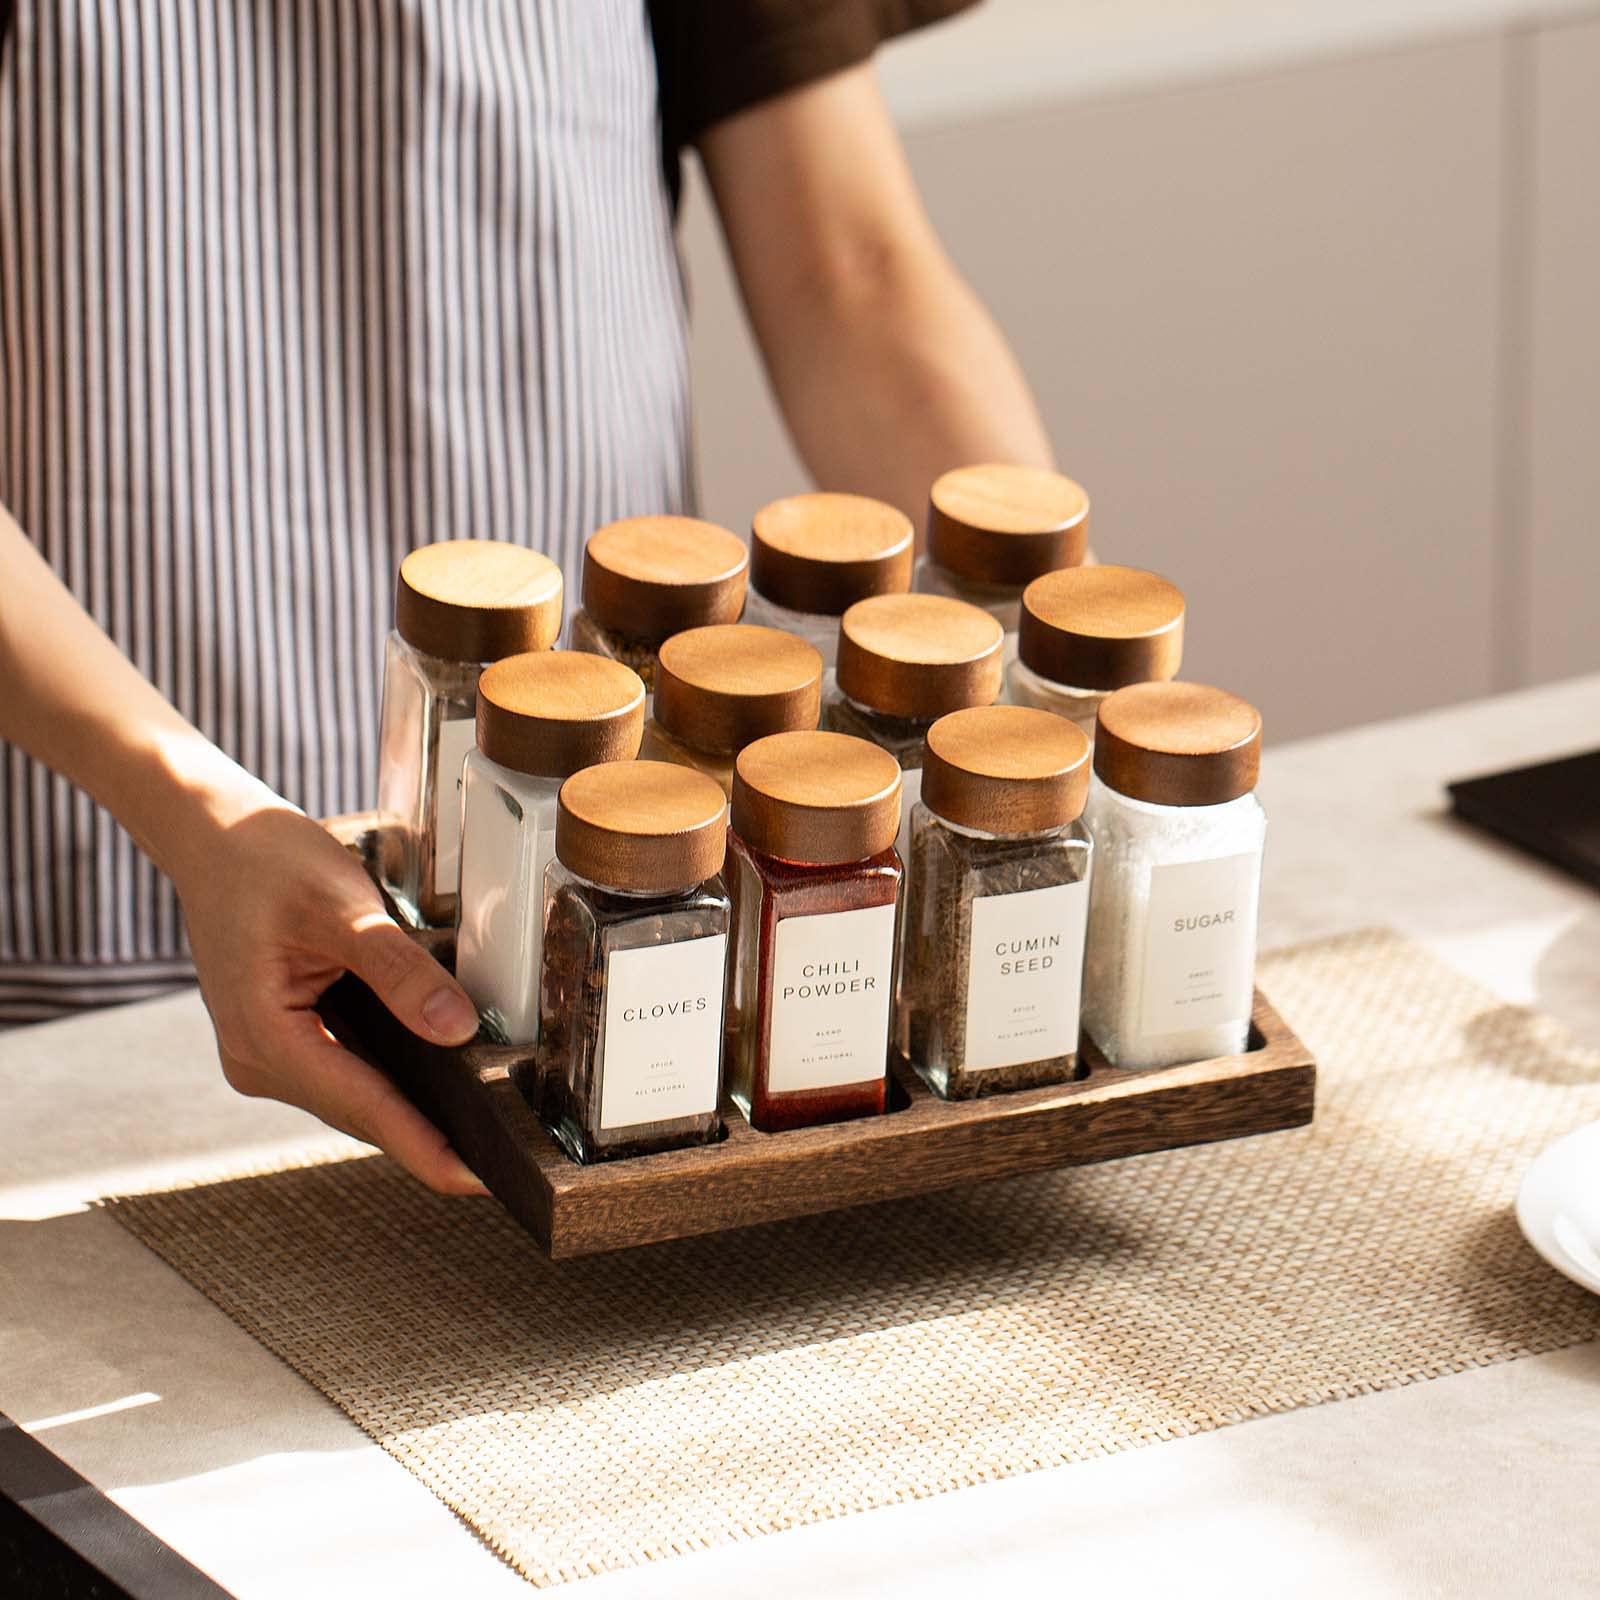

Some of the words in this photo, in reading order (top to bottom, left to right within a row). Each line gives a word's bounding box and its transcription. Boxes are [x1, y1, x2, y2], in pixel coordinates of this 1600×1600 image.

[1174, 910, 1234, 932] SUGAR
[995, 934, 1060, 956] CUMIN
[802, 959, 859, 978] CHILI
[1000, 955, 1053, 975] SEED
[783, 976, 875, 1000] POWDER
[623, 997, 706, 1022] CLOVES
[652, 1083, 686, 1094] NATURAL
